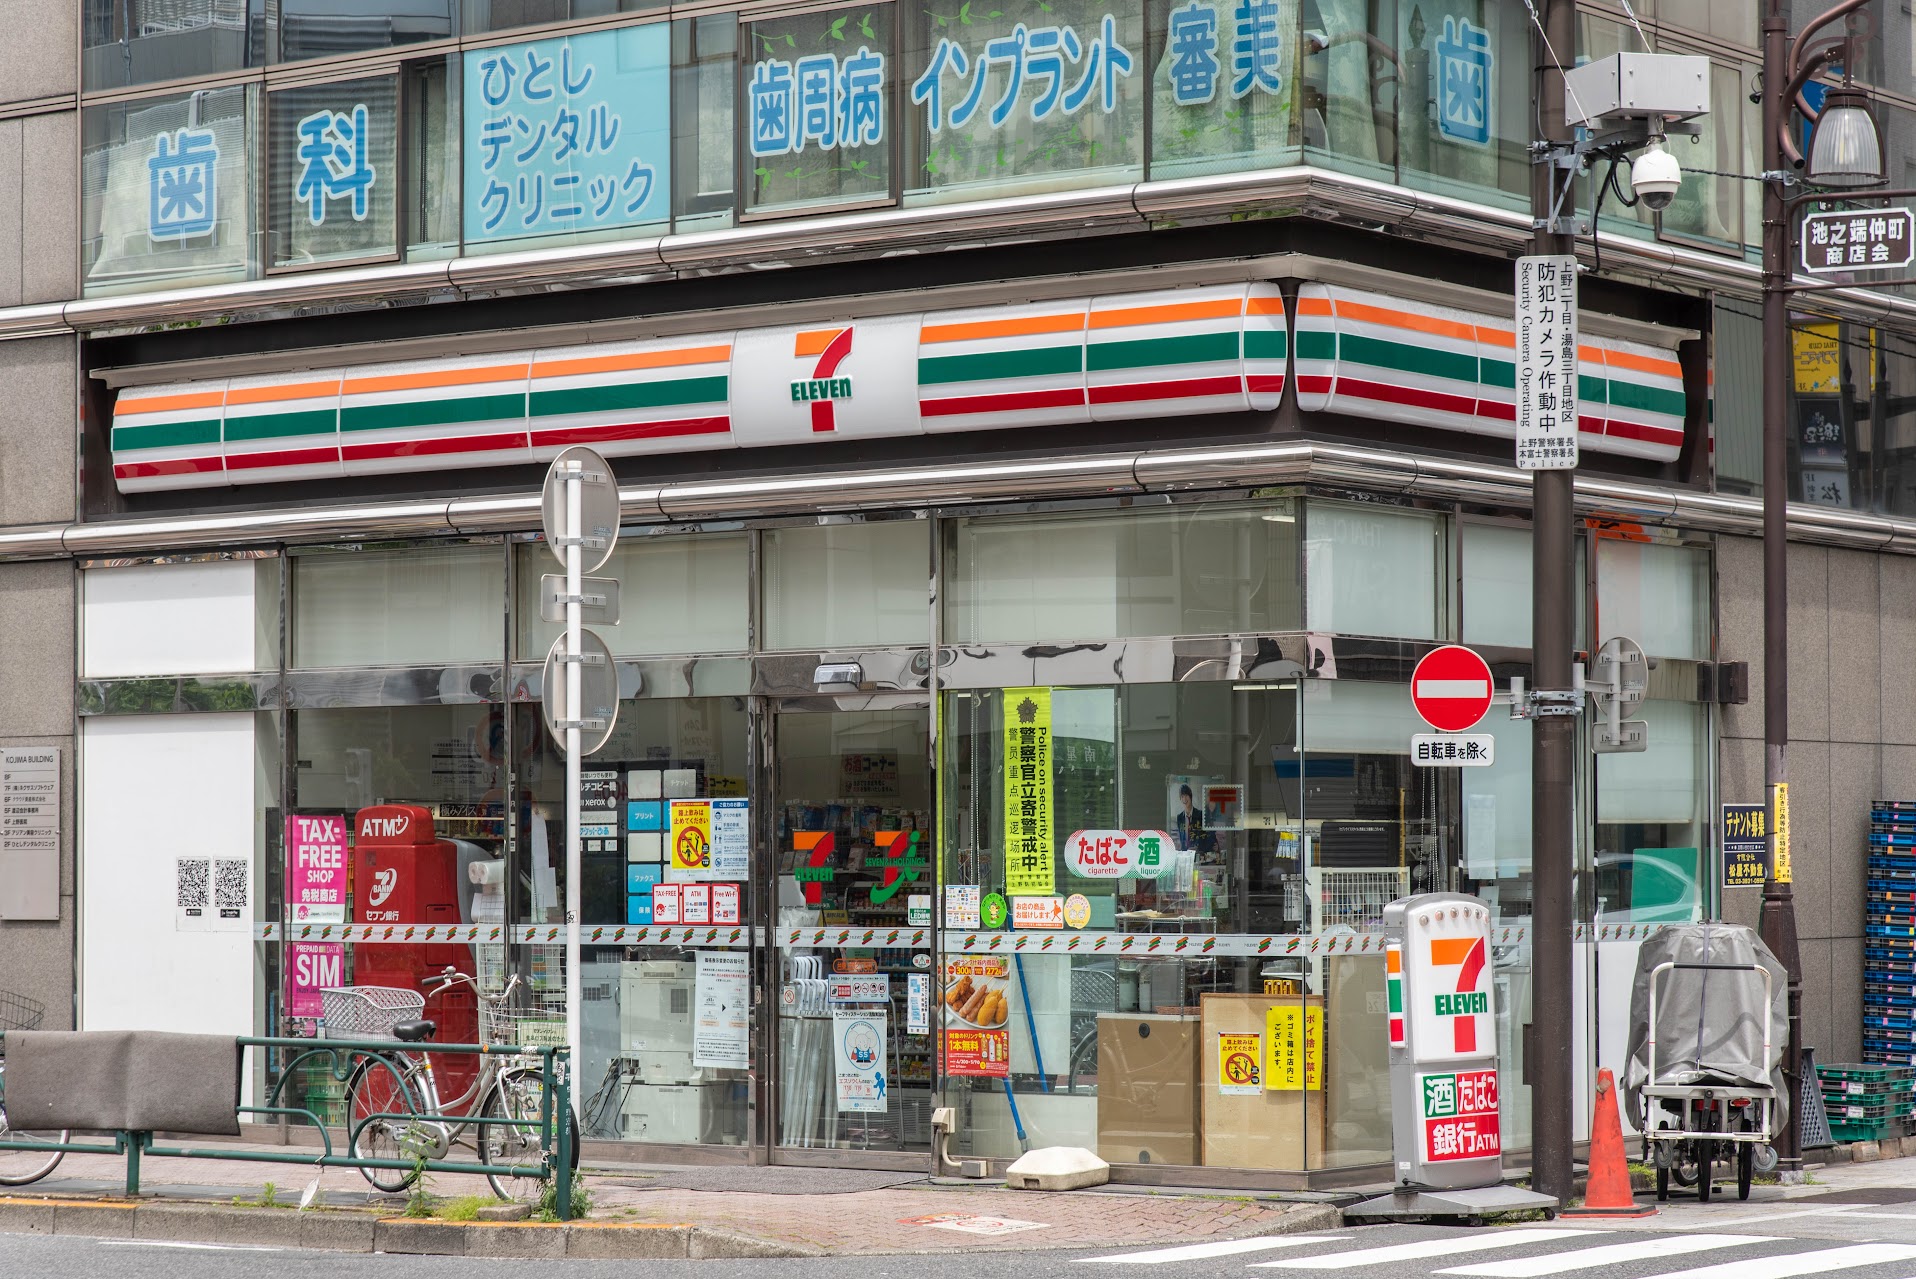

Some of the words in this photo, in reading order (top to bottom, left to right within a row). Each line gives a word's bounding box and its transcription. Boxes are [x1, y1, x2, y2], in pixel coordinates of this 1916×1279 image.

[1169, 0, 1284, 106] 審美
[477, 44, 594, 107] ひとし
[911, 12, 1134, 134] インプラント
[748, 45, 886, 158] 歯周病
[478, 103, 622, 174] デンタル
[478, 157, 655, 235] クリニック
[1811, 217, 1905, 245] 池之端仲町
[1826, 243, 1889, 265] 商店会
[1520, 262, 1533, 311] Security
[1521, 316, 1533, 363] Camera
[1537, 262, 1557, 433] 防犯カメラ作動中
[1560, 261, 1574, 423] 上野二丁目・湯島三丁目地区
[794, 324, 856, 433] 7
[1520, 367, 1534, 428] Operating
[1519, 437, 1575, 448] 上野警察署長
[1519, 448, 1575, 458] 本富士警察署長
[1519, 460, 1575, 468] Police
[5, 755, 27, 764] KOJIMA
[28, 755, 54, 764] BUILDING
[1038, 727, 1047, 767] Police
[1418, 741, 1487, 760] 自転車を除く
[1038, 769, 1046, 785] on
[1019, 727, 1038, 872] 警察官立寄警戒中
[1038, 788, 1048, 840] security
[361, 818, 396, 837] ATM
[634, 812, 654, 820] プリント
[1726, 810, 1765, 837] テナント募集
[298, 845, 342, 868] FREE
[1039, 842, 1049, 871] alert
[1078, 835, 1128, 865] たばこ
[1138, 837, 1161, 866] 酒
[1736, 854, 1756, 862] 有限会社
[307, 870, 334, 883] SHOP
[793, 831, 835, 904] 7
[1087, 867, 1119, 876] cigarette
[1140, 866, 1161, 876] liquor
[365, 910, 400, 922] セブン銀行
[1015, 903, 1046, 911] お店の商品
[296, 954, 340, 987] SIM
[1430, 936, 1486, 1053] 7
[949, 1040, 979, 1051] 1本無料
[1306, 1014, 1316, 1084] ポイ捨て禁止
[1425, 1077, 1455, 1116] 酒
[1458, 1073, 1498, 1112] たばこ
